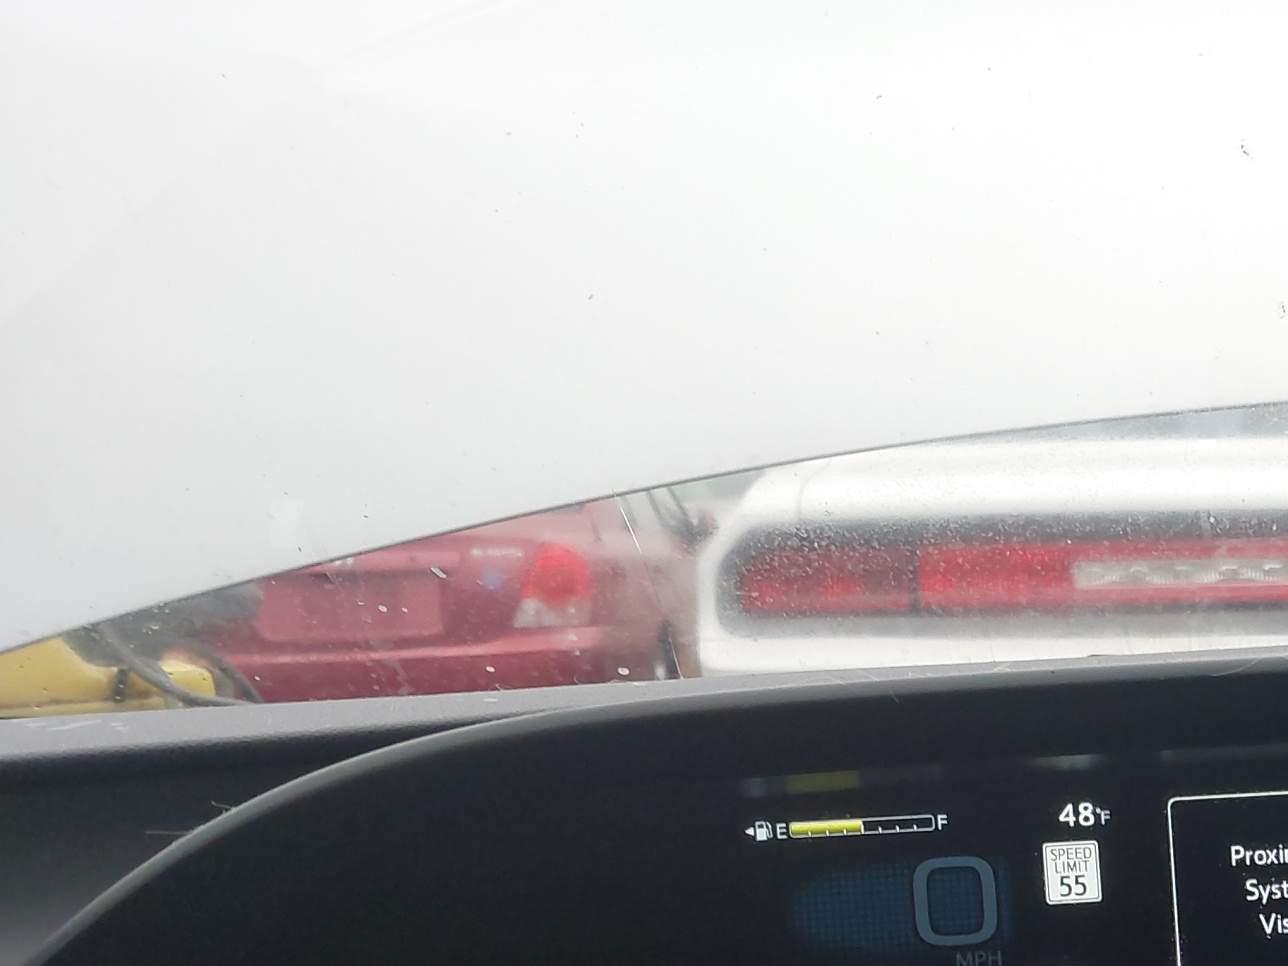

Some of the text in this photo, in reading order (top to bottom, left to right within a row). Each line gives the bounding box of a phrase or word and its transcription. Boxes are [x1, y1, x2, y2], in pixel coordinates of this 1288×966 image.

[937, 815, 948, 831] F
[776, 824, 789, 840] E
[1050, 847, 1092, 861] SPEED
[1054, 860, 1090, 874] LIMIT
[1060, 874, 1087, 897] 55
